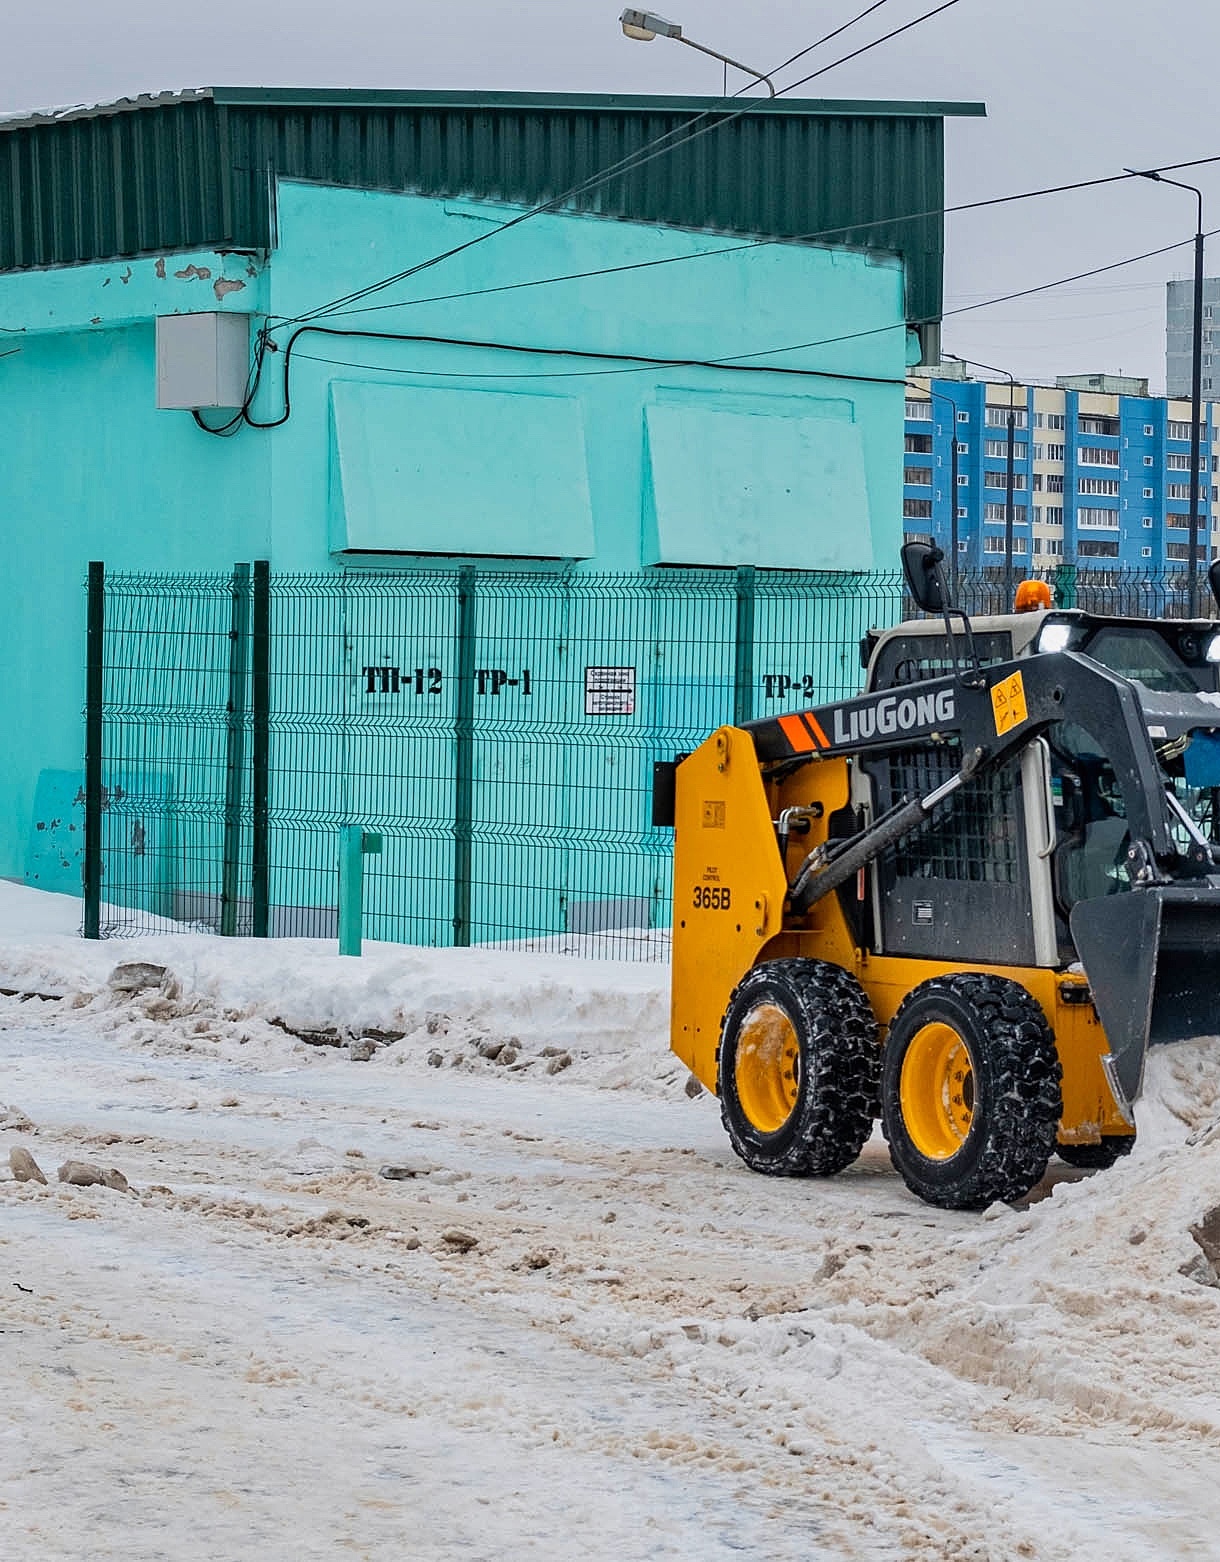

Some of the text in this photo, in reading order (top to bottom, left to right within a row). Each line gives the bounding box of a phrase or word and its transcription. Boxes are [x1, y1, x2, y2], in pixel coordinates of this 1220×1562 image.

[362, 666, 531, 695] ТП-12 ТР-1
[762, 674, 815, 699] ТР-2
[693, 886, 730, 910] 365B
